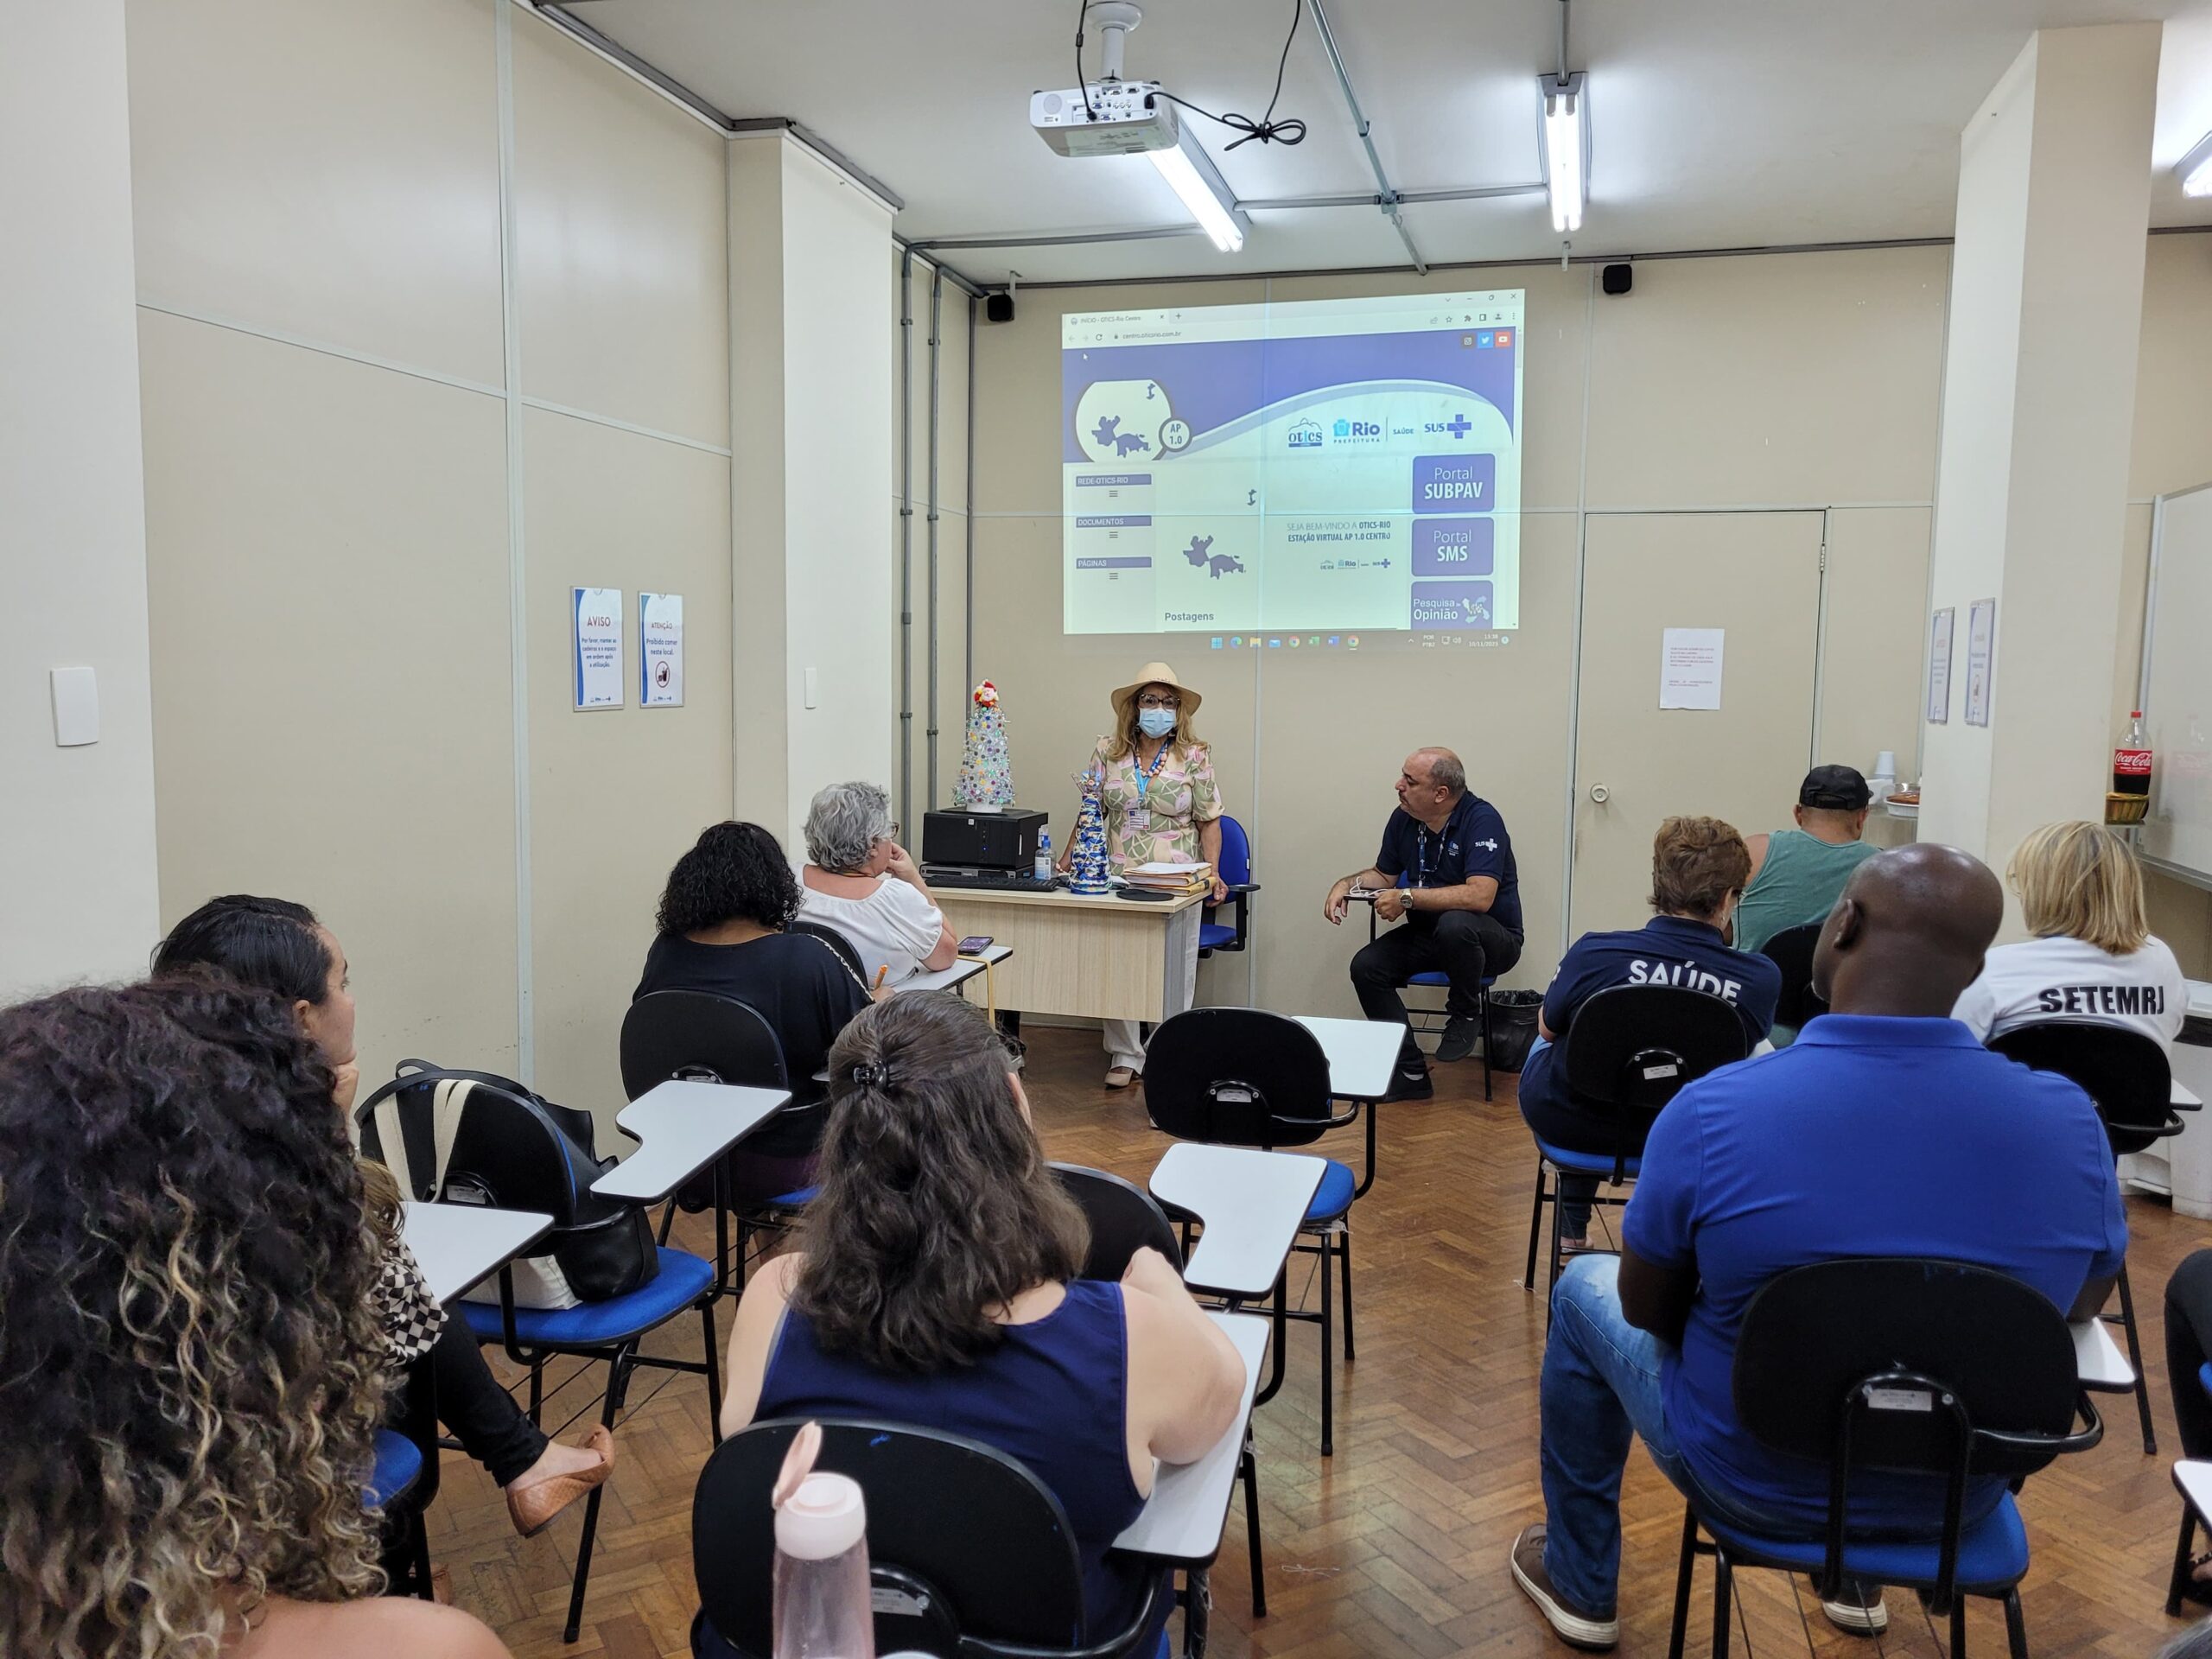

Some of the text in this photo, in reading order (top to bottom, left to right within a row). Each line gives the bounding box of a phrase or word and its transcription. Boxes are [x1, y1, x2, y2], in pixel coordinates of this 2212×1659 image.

[1170, 423, 1181, 433] AP
[1352, 422, 1381, 436] Rio
[1393, 427, 1414, 435] SAÚDE
[1424, 423, 1446, 433] SUS
[1169, 435, 1183, 445] 1.0
[1434, 466, 1473, 480] Portal
[1424, 481, 1484, 499] SUBPAV
[1287, 520, 1391, 531] SEJA BEM-VINDO A OTICS-RIO
[1287, 532, 1315, 543] ESTAÇÃO
[1316, 533, 1344, 542] VIRTUAL
[1433, 529, 1472, 543] Portal
[1437, 545, 1468, 562] SMS
[1077, 559, 1107, 568] PÁGINAS
[1413, 597, 1455, 608] Pesquisa
[1165, 612, 1214, 622] Postagens
[1414, 608, 1459, 622] Opinião
[587, 616, 611, 627] AVISO
[651, 620, 673, 631] ATENÇÃO
[2115, 751, 2152, 766] Coca-Cola
[1628, 960, 1742, 1007] SAÚDE
[2038, 985, 2164, 1015] SETEMRJ
